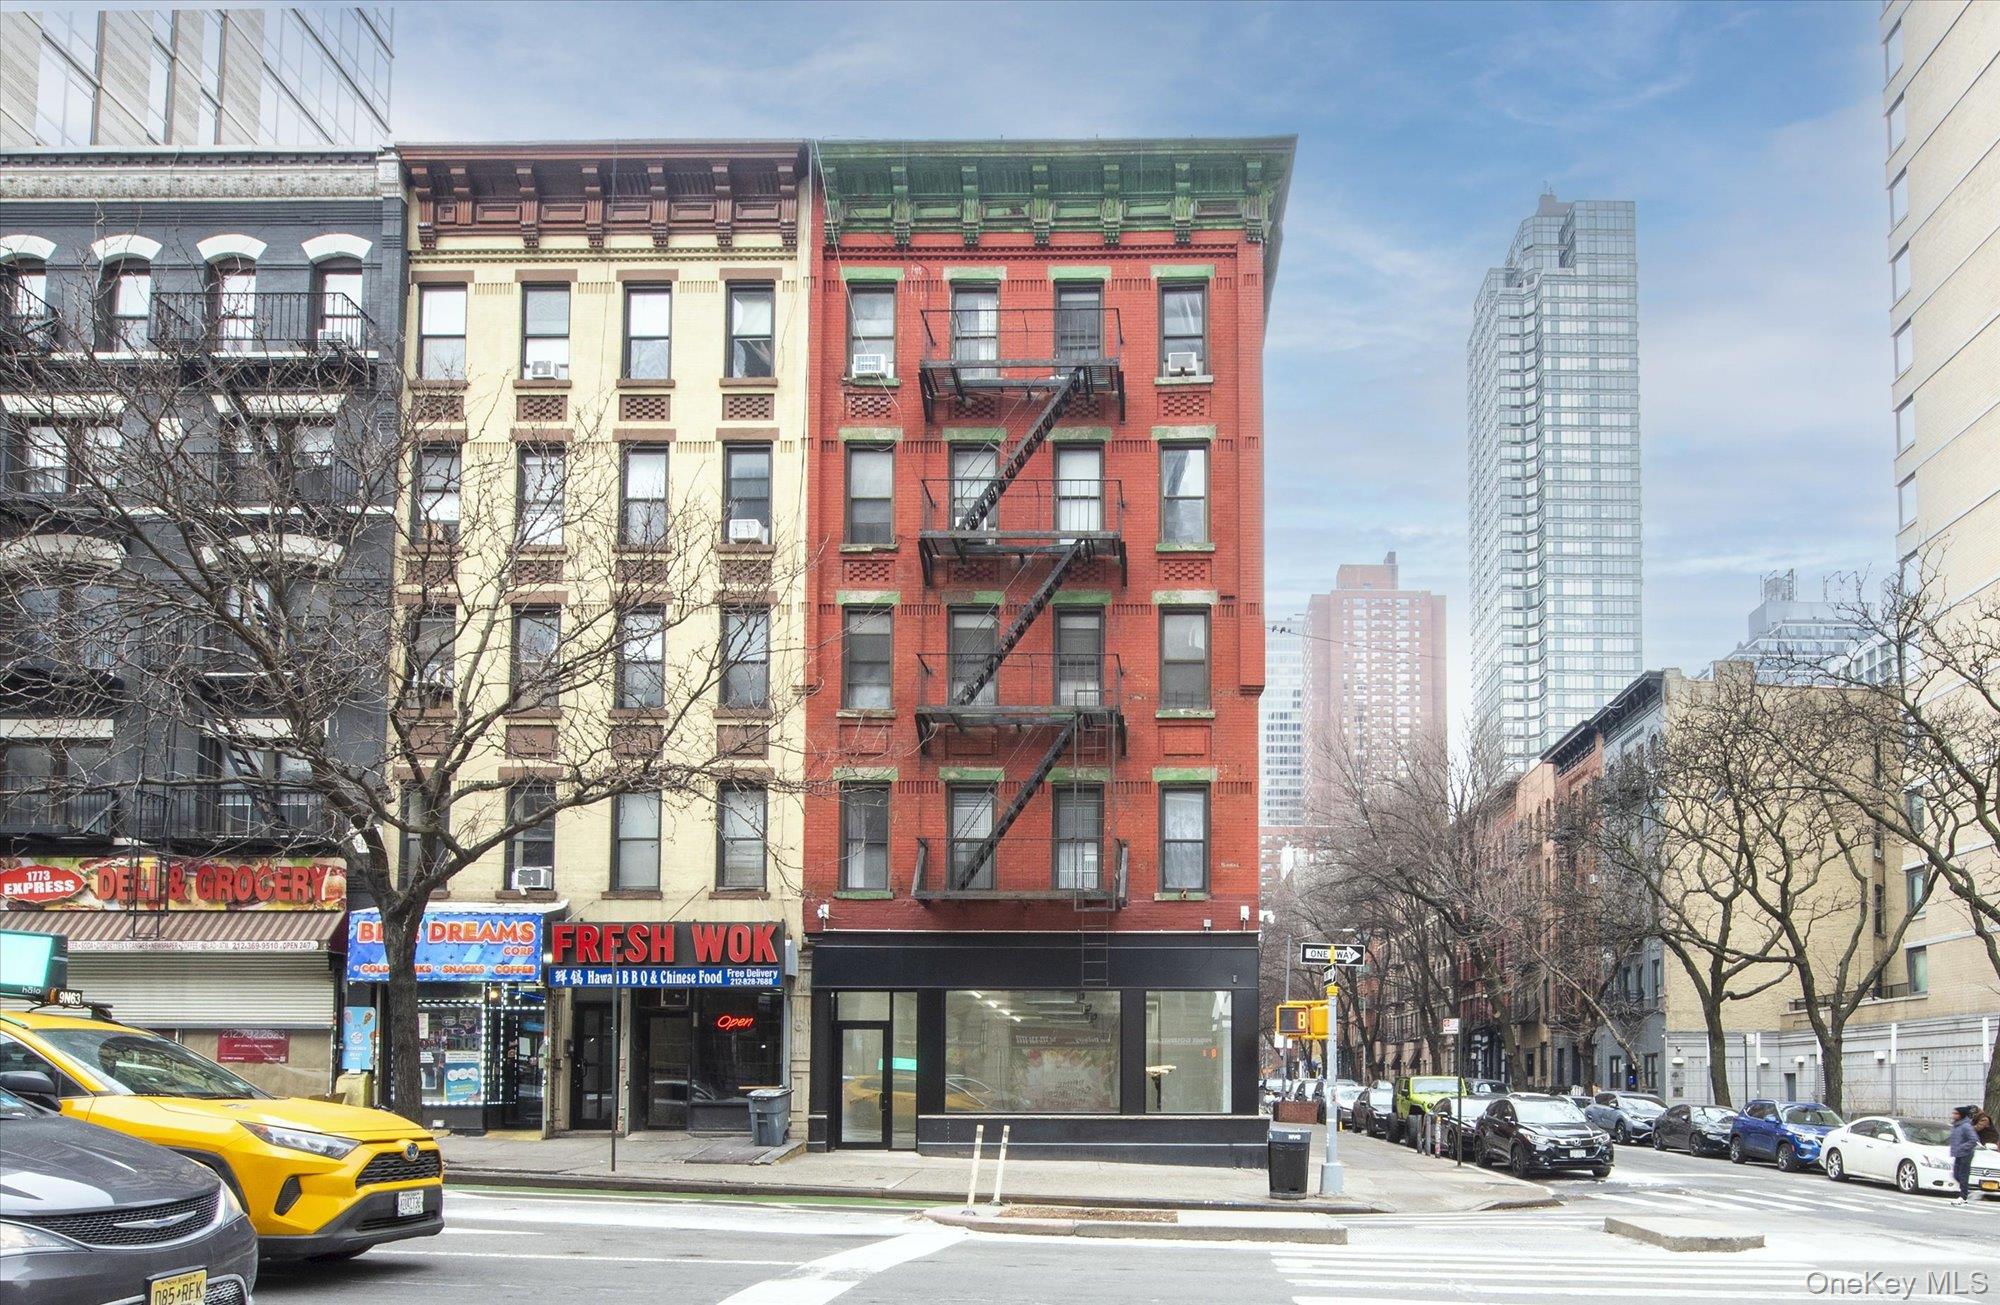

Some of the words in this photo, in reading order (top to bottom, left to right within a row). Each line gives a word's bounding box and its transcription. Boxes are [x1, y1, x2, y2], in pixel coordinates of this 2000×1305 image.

[27, 870, 50, 881] 1773
[3, 879, 76, 895] EXPRESS
[98, 866, 158, 901] DELI
[195, 864, 329, 901] GROCERY
[428, 921, 536, 944] DREAMS
[552, 924, 675, 963] FRESH
[691, 924, 779, 963] WOK
[503, 946, 534, 956] CORP
[1310, 950, 1328, 958] ONE
[1337, 951, 1355, 959] WAY
[441, 964, 486, 975] SNACKS
[495, 964, 535, 975] COFFEE
[727, 968, 745, 978] Free
[746, 968, 778, 979] Delivery
[660, 970, 696, 984] Chinese
[699, 970, 723, 984] Food
[59, 991, 81, 1004] 9N63
[717, 1014, 754, 1031] Open
